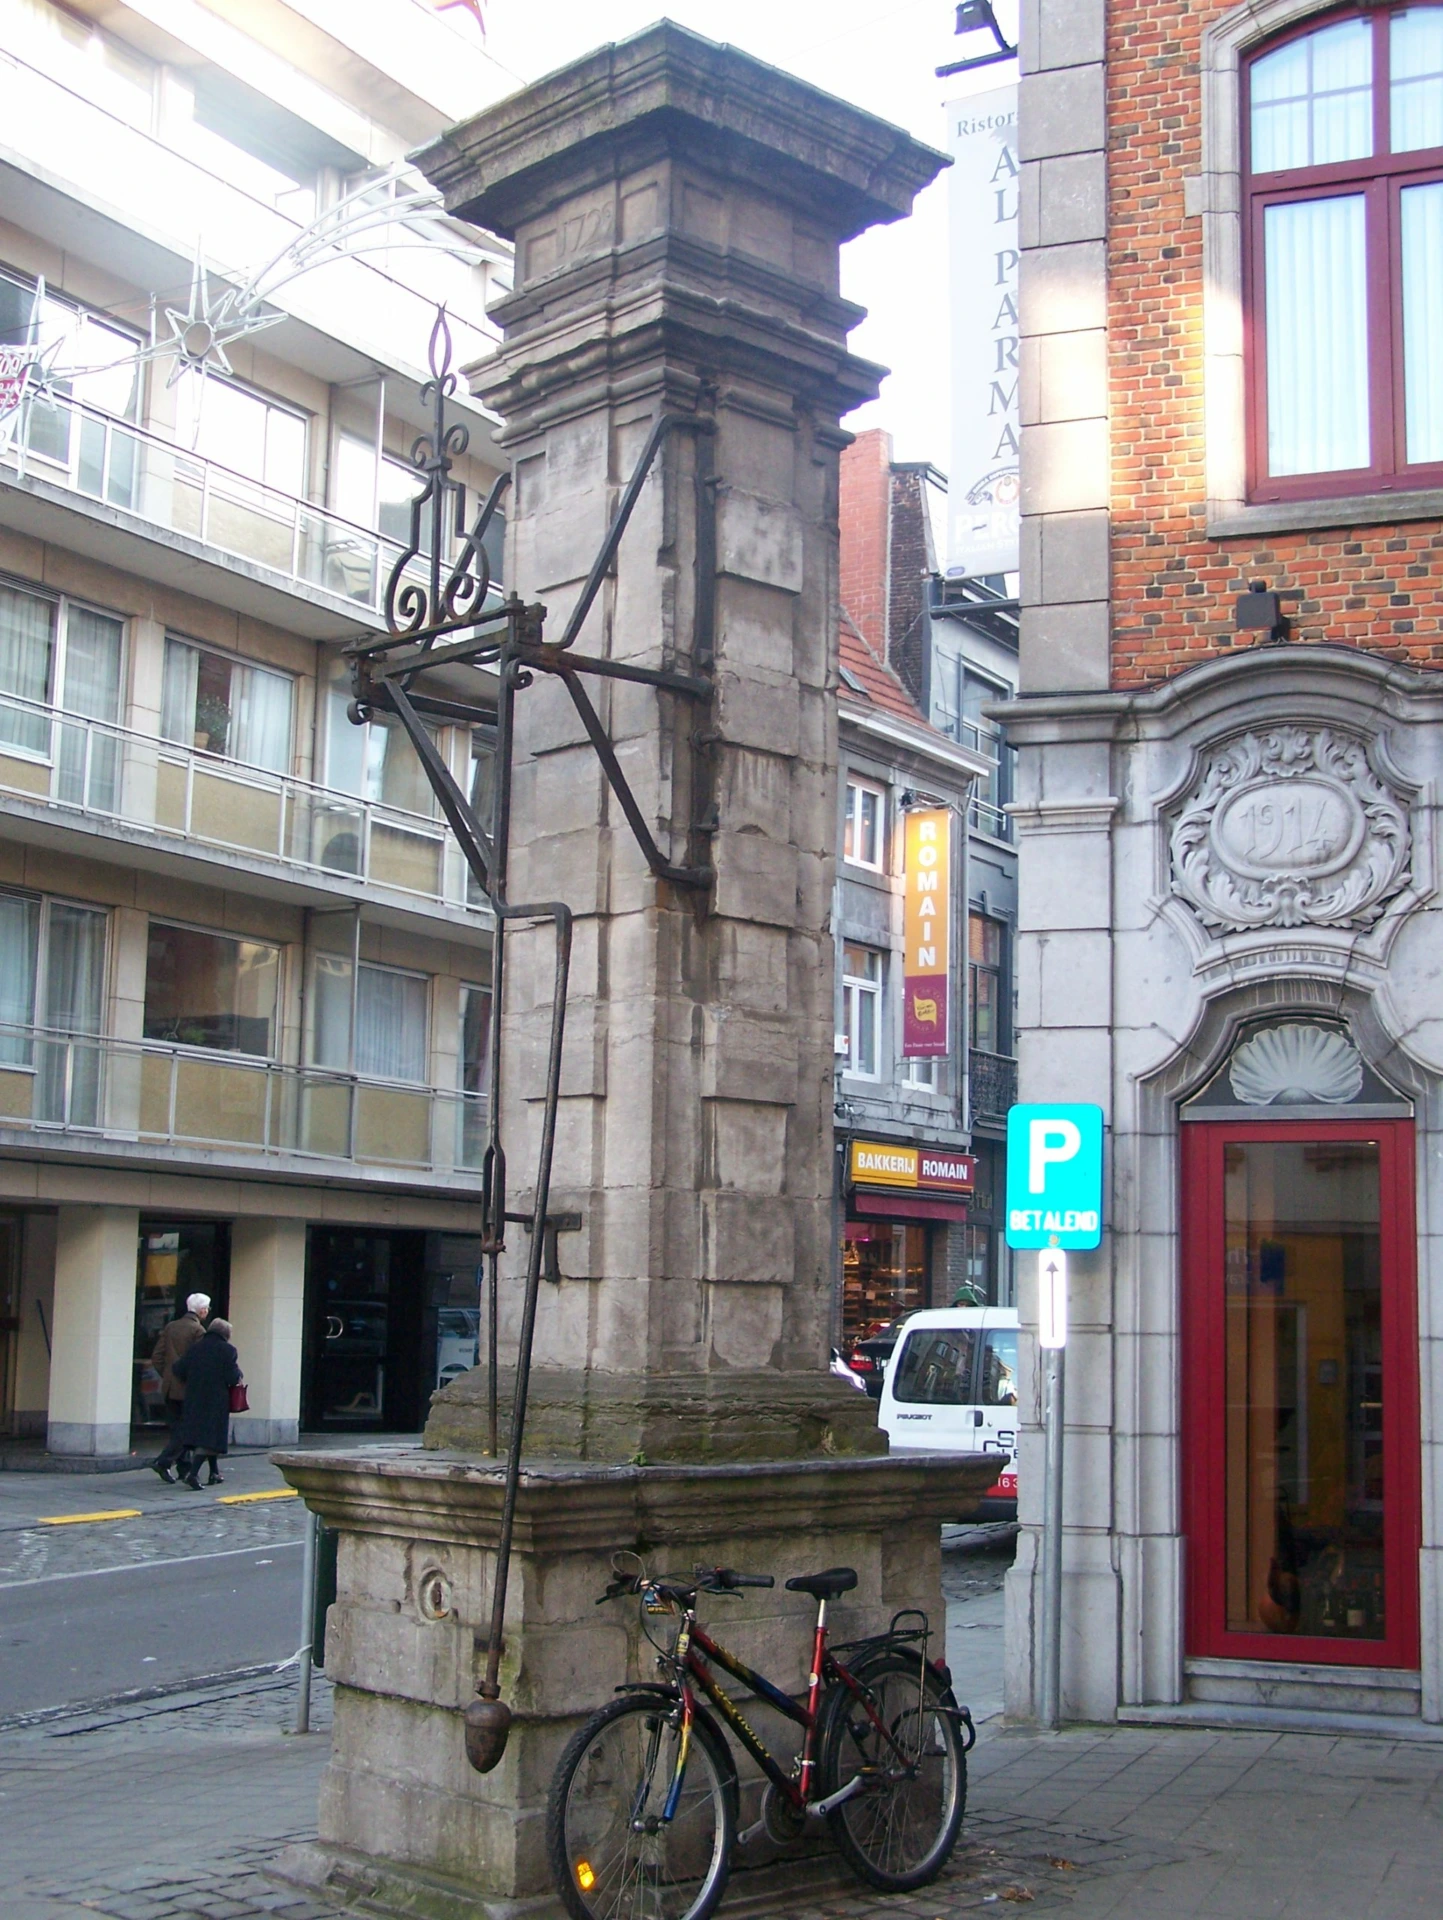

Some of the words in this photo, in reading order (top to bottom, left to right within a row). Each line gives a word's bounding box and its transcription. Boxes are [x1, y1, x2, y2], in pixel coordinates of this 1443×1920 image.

[957, 111, 1018, 138] Ristor
[1238, 799, 1340, 860] 1914
[916, 820, 938, 968] ROMAIN
[857, 1152, 915, 1174] BAKKERIJ
[922, 1159, 968, 1181] ROMAIN
[1028, 1118, 1082, 1195] P
[1009, 1209, 1099, 1232] BETALEND
